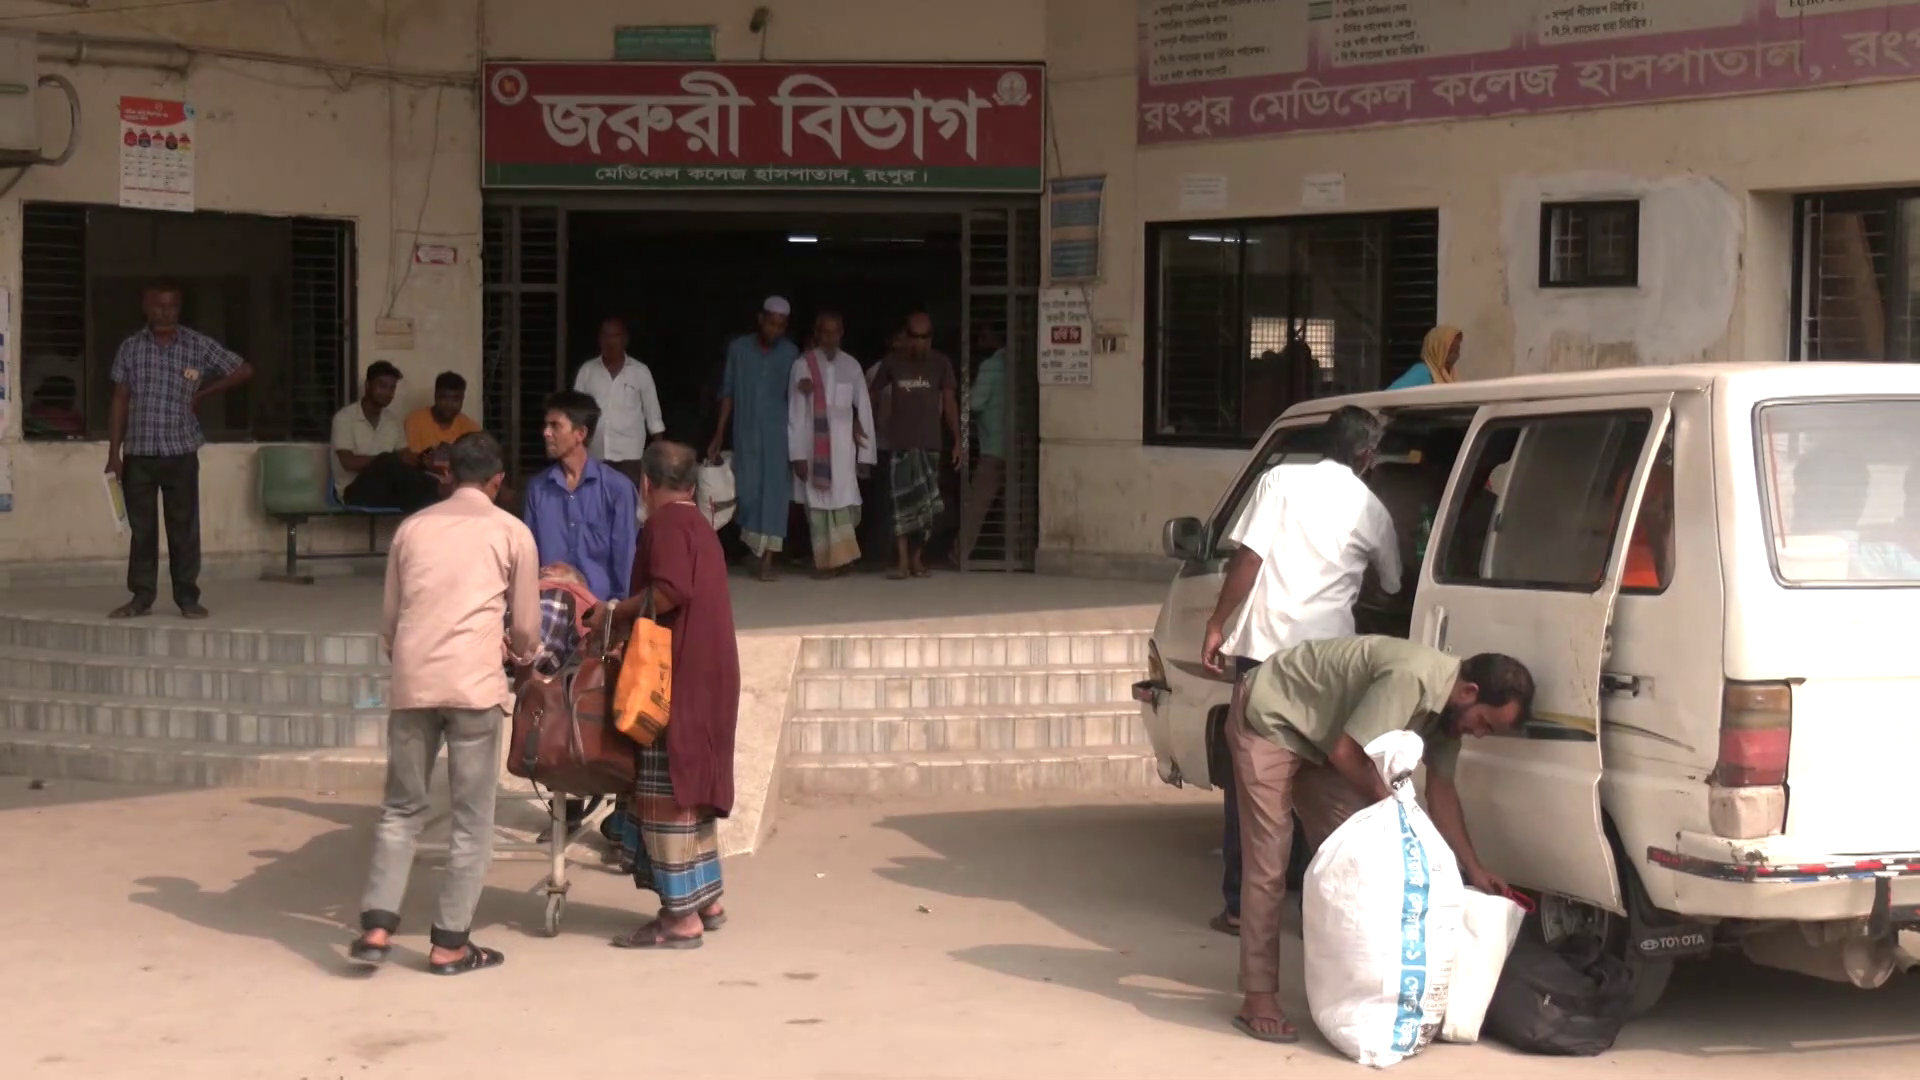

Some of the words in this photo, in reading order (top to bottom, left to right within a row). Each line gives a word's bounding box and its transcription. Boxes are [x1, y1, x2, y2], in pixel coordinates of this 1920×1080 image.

[1142, 96, 1234, 136] রংপুর
[1249, 78, 1415, 122] মেডিকেল
[1427, 64, 1560, 106] কলেজ
[1571, 39, 1823, 98] হাসপাতাল,
[532, 70, 757, 158] জরুরী
[768, 73, 993, 160] বিভাগ
[595, 165, 680, 181] মেডিকেল
[687, 167, 748, 182] কলেজ
[1660, 933, 1705, 949] TOYOTA
